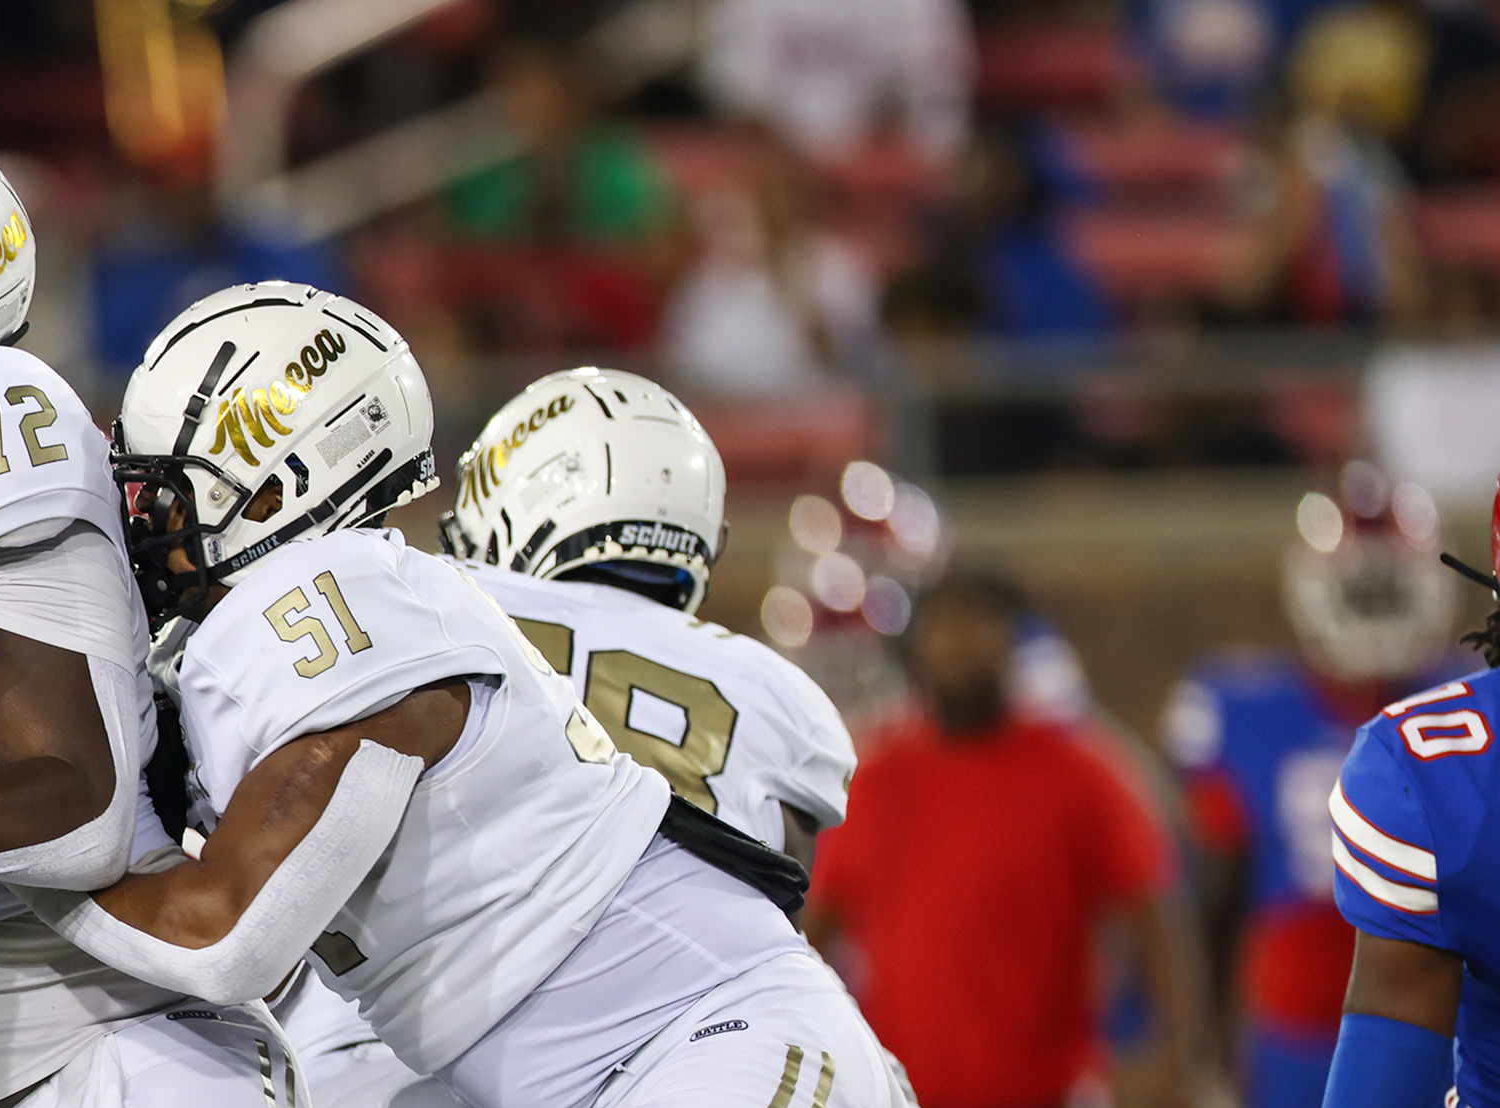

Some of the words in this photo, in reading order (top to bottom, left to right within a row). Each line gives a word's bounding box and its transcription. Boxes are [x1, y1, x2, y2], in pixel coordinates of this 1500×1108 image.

[208, 329, 347, 467] Mecca
[461, 395, 577, 517] Mecca
[231, 534, 281, 571] schutt
[618, 522, 699, 554] schutt
[262, 570, 373, 679] 51
[1381, 682, 1495, 763] 10
[694, 1021, 743, 1038] BATTLE
